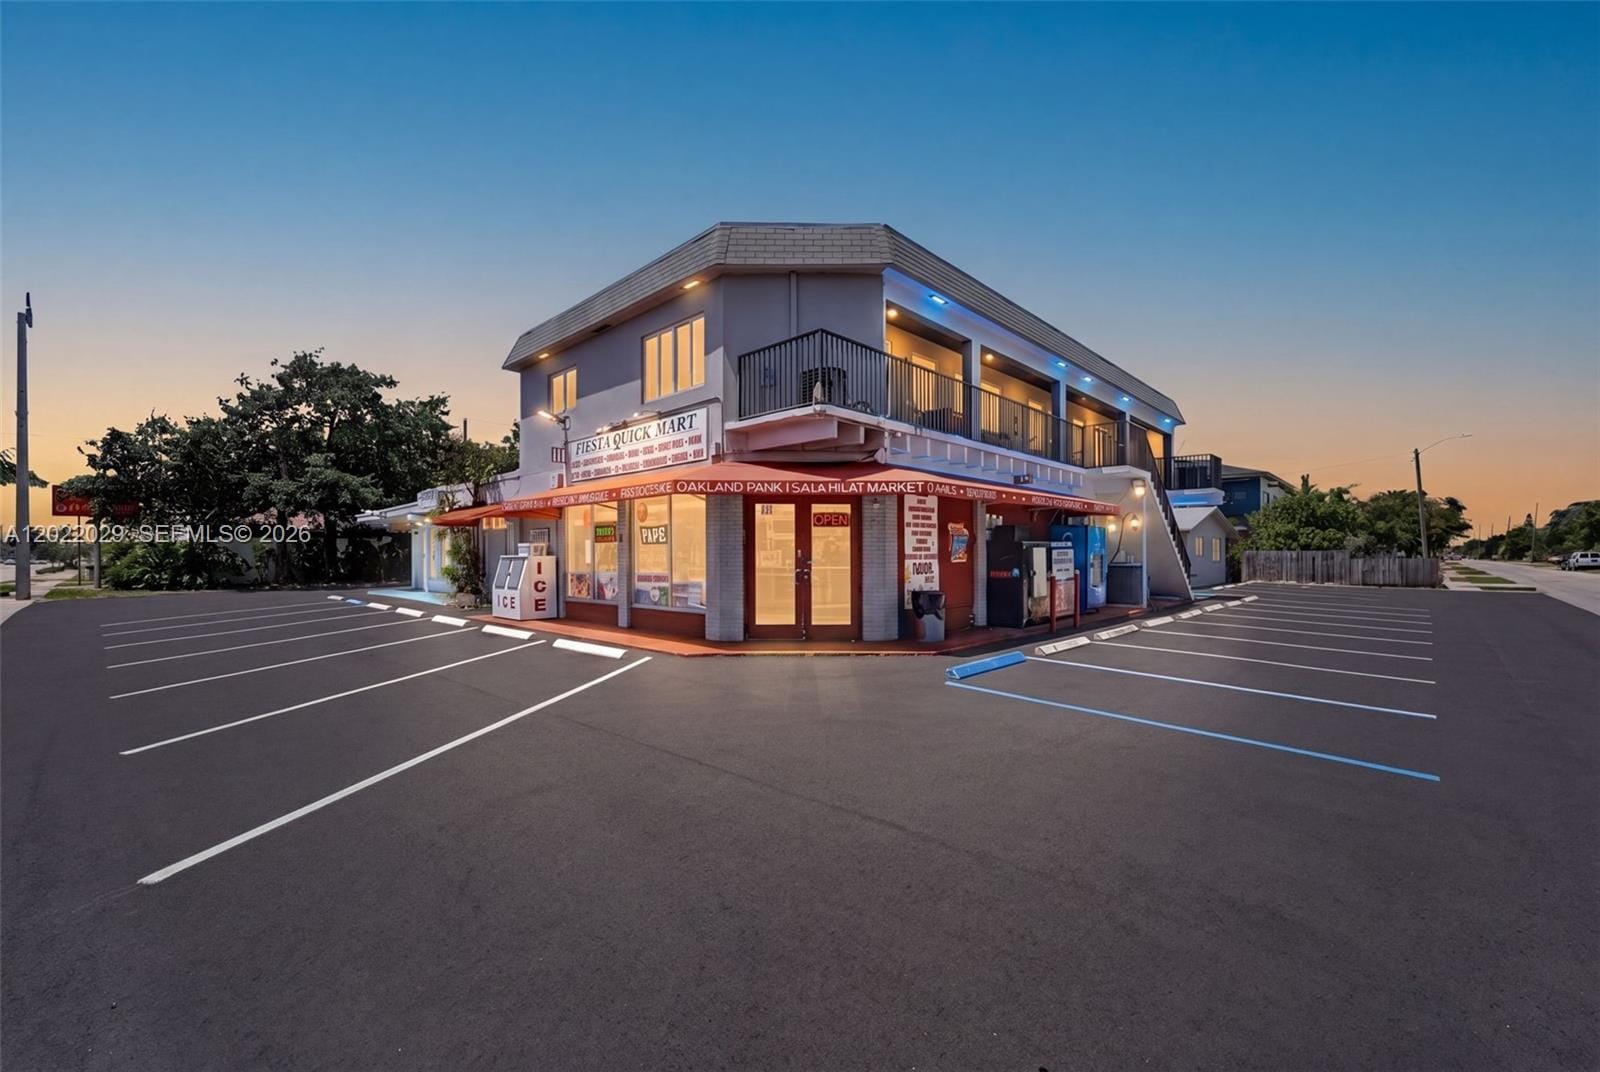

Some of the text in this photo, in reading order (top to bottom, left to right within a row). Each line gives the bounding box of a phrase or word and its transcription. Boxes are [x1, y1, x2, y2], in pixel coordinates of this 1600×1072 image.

[575, 435, 612, 456] FIESTA
[612, 423, 652, 451] QUICK
[655, 413, 697, 436] MART
[676, 481, 744, 493] OAKLAND
[746, 481, 783, 493] PANK
[791, 481, 826, 493] SALA
[828, 482, 864, 493] HILAT
[866, 481, 925, 493] MARKET
[814, 514, 849, 526] OPEN
[533, 561, 547, 612] ICE
[496, 594, 516, 610] ICE
